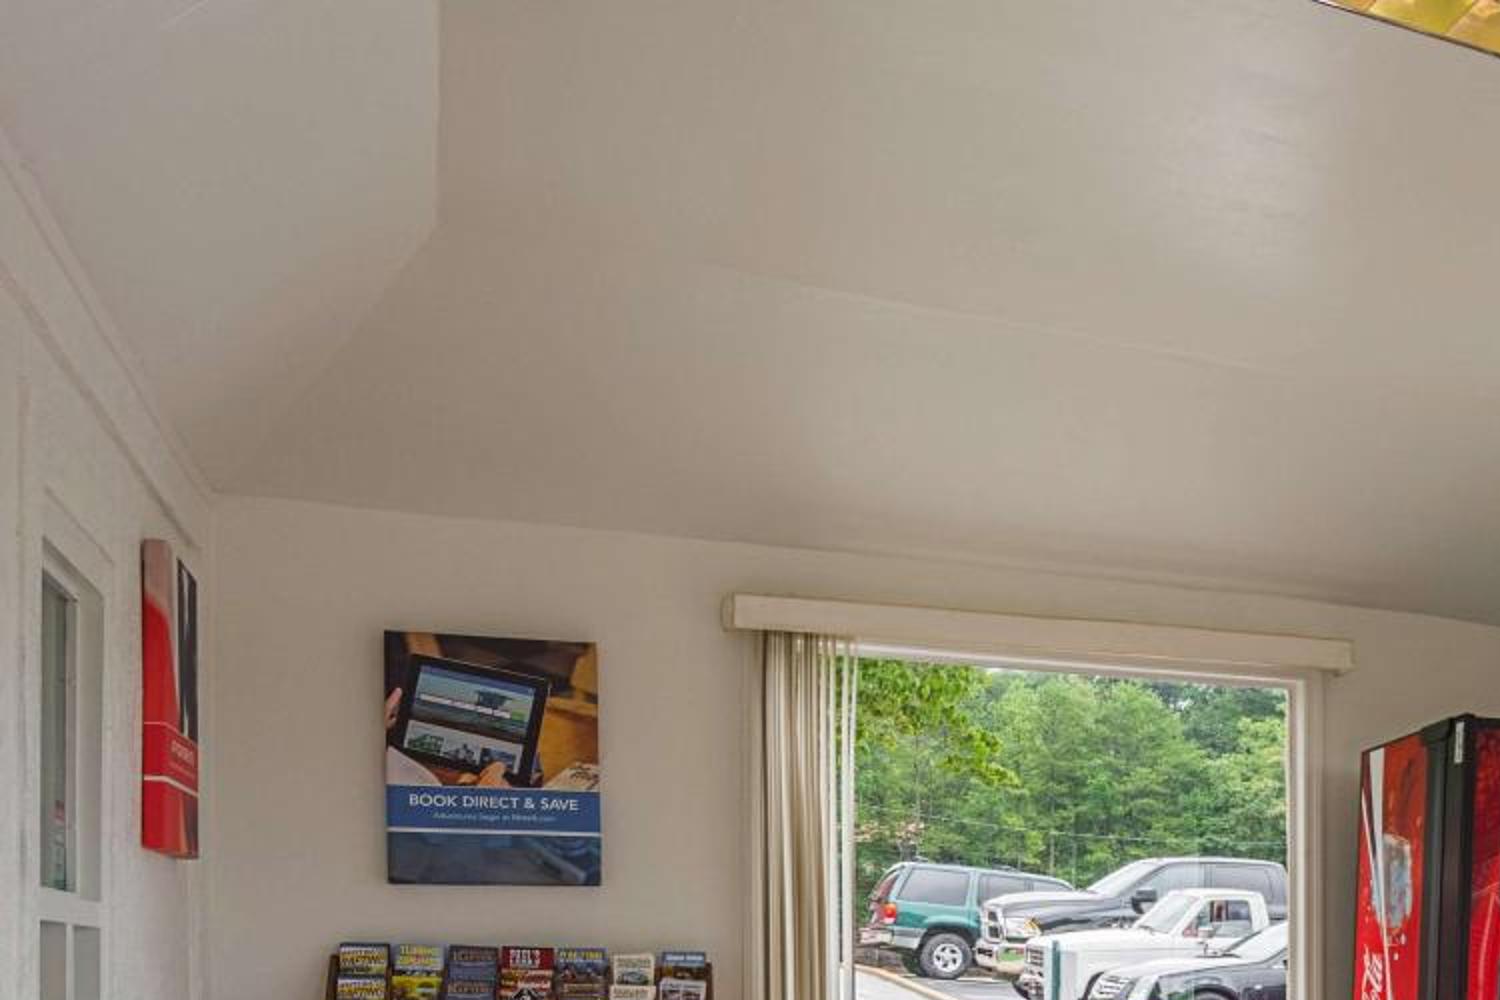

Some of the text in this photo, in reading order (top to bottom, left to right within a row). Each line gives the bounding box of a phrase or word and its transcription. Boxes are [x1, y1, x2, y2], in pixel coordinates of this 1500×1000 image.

[409, 793, 579, 811] BOOK DIRECT & SAVE
